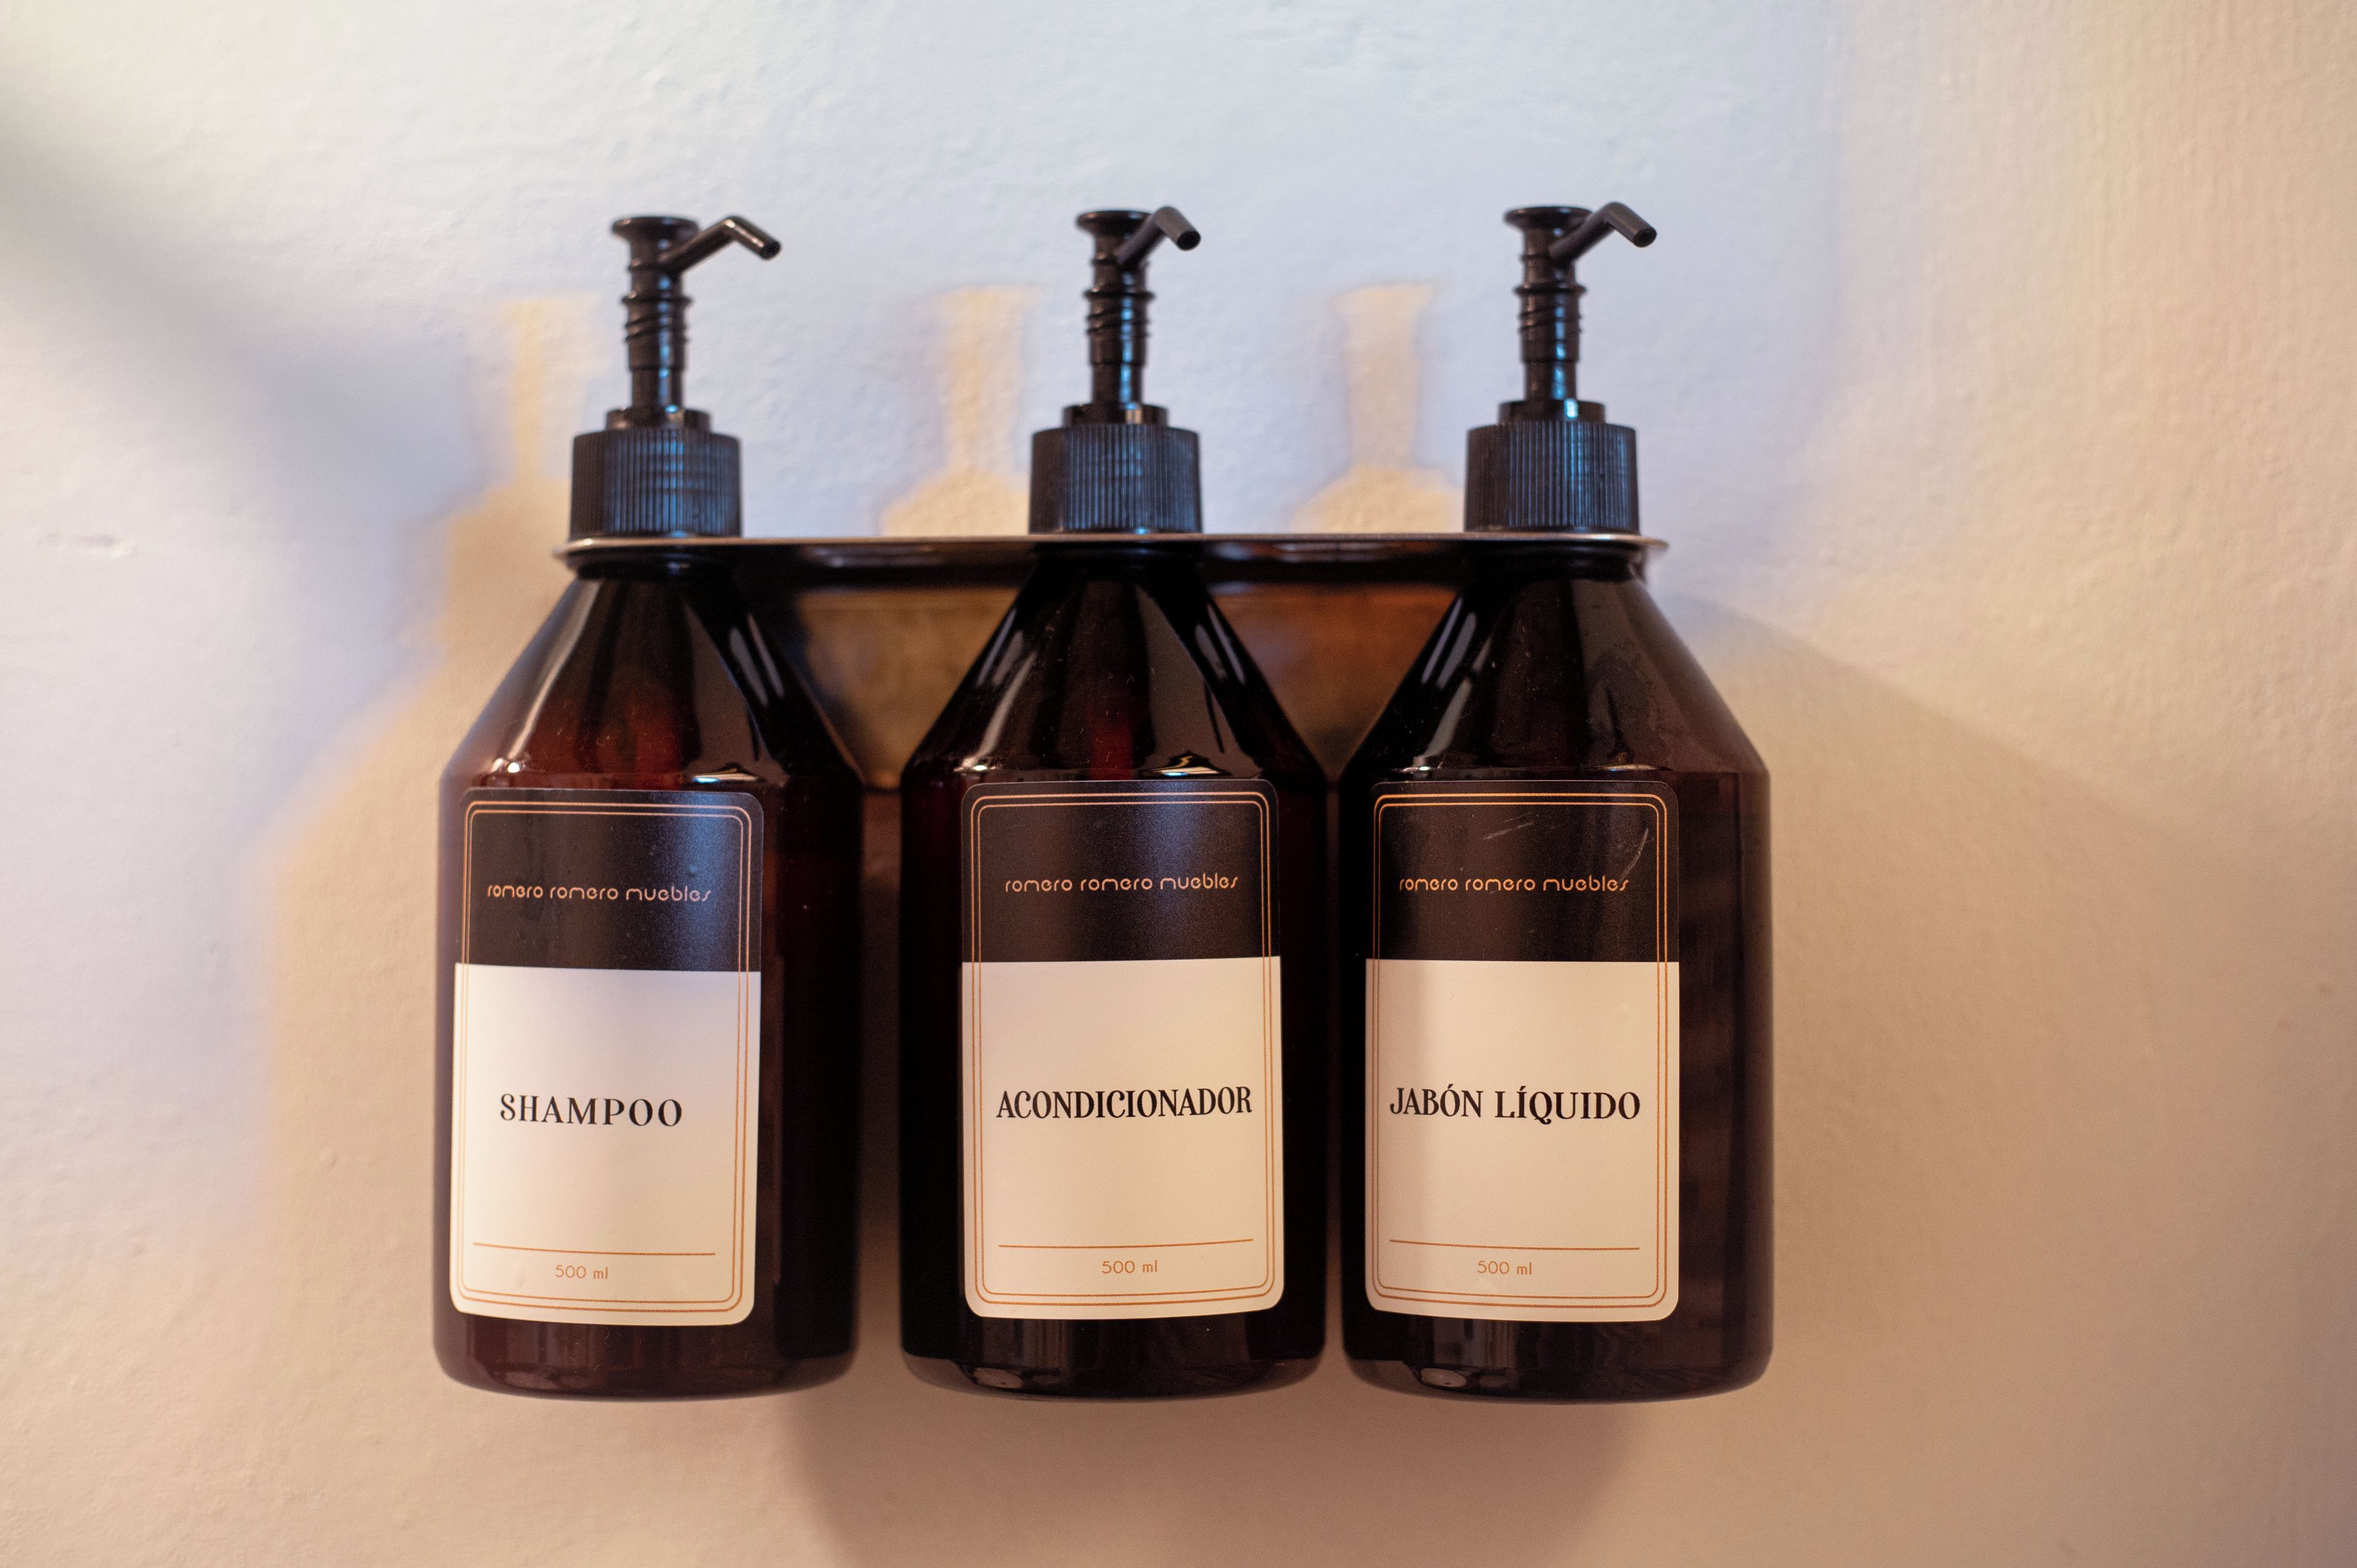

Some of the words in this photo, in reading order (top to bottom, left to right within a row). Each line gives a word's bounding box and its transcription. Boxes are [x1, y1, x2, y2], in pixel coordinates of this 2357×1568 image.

[1005, 876, 1074, 892] romero
[1080, 875, 1153, 891] romero
[1160, 872, 1239, 890] muebles
[1399, 876, 1458, 892] romero
[1465, 876, 1536, 892] romero
[1542, 875, 1630, 892] muebles
[487, 884, 543, 898] romero
[549, 884, 619, 900] romero
[626, 884, 712, 902] muebles
[500, 1093, 683, 1127] SHAMPOO
[996, 1086, 1253, 1119] ACONDICIONADOR
[1390, 1084, 1484, 1118] JABÓN
[1495, 1086, 1641, 1126] LÍQUIDO
[555, 1264, 587, 1280] 500
[593, 1267, 609, 1280] ml
[1101, 1260, 1136, 1275] 500
[1142, 1259, 1158, 1273] ml
[1477, 1260, 1510, 1275] 500
[1517, 1262, 1533, 1276] ml
